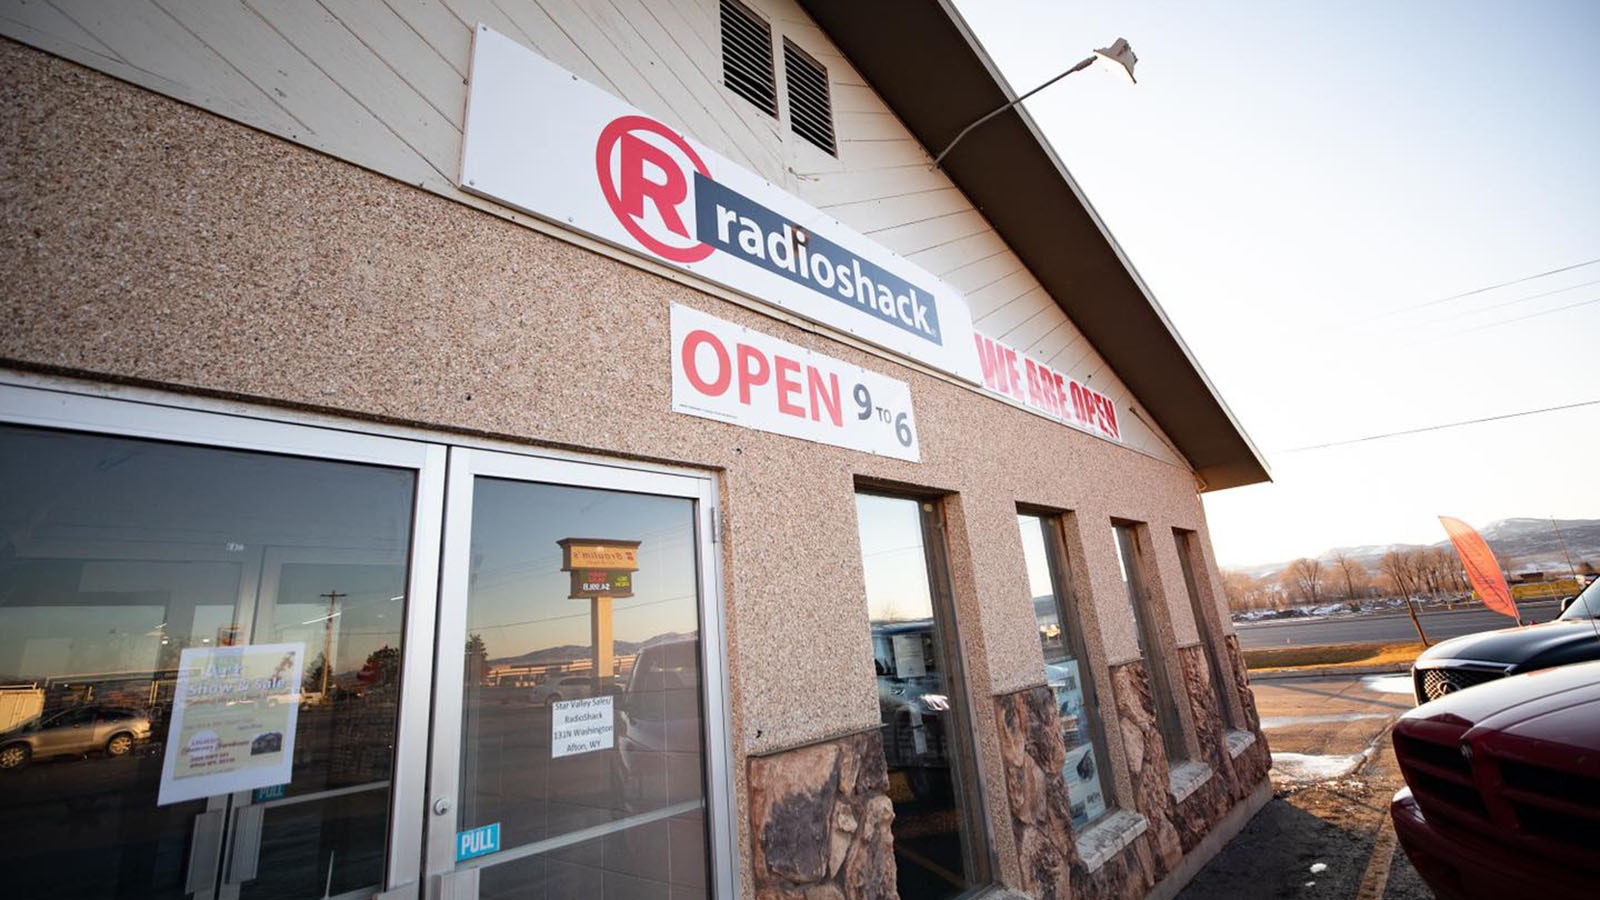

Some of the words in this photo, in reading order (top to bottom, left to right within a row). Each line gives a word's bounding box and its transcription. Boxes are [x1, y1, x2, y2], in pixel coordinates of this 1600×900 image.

[715, 203, 933, 336] radioshack
[681, 330, 843, 428] OPEN
[853, 383, 872, 420] 9
[876, 406, 892, 425] TO
[895, 412, 913, 448] 6
[974, 333, 1025, 401] WE
[1024, 357, 1072, 420] ARE
[1069, 380, 1121, 440] OPEN
[188, 681, 234, 696] Show
[254, 677, 287, 691] Sale
[554, 702, 569, 711] Star
[569, 699, 592, 709] Valley
[564, 711, 603, 723] RadioShack
[573, 725, 613, 738] Washington
[566, 742, 588, 753] Afton,
[589, 740, 601, 749] WY
[461, 828, 495, 856] PULL
